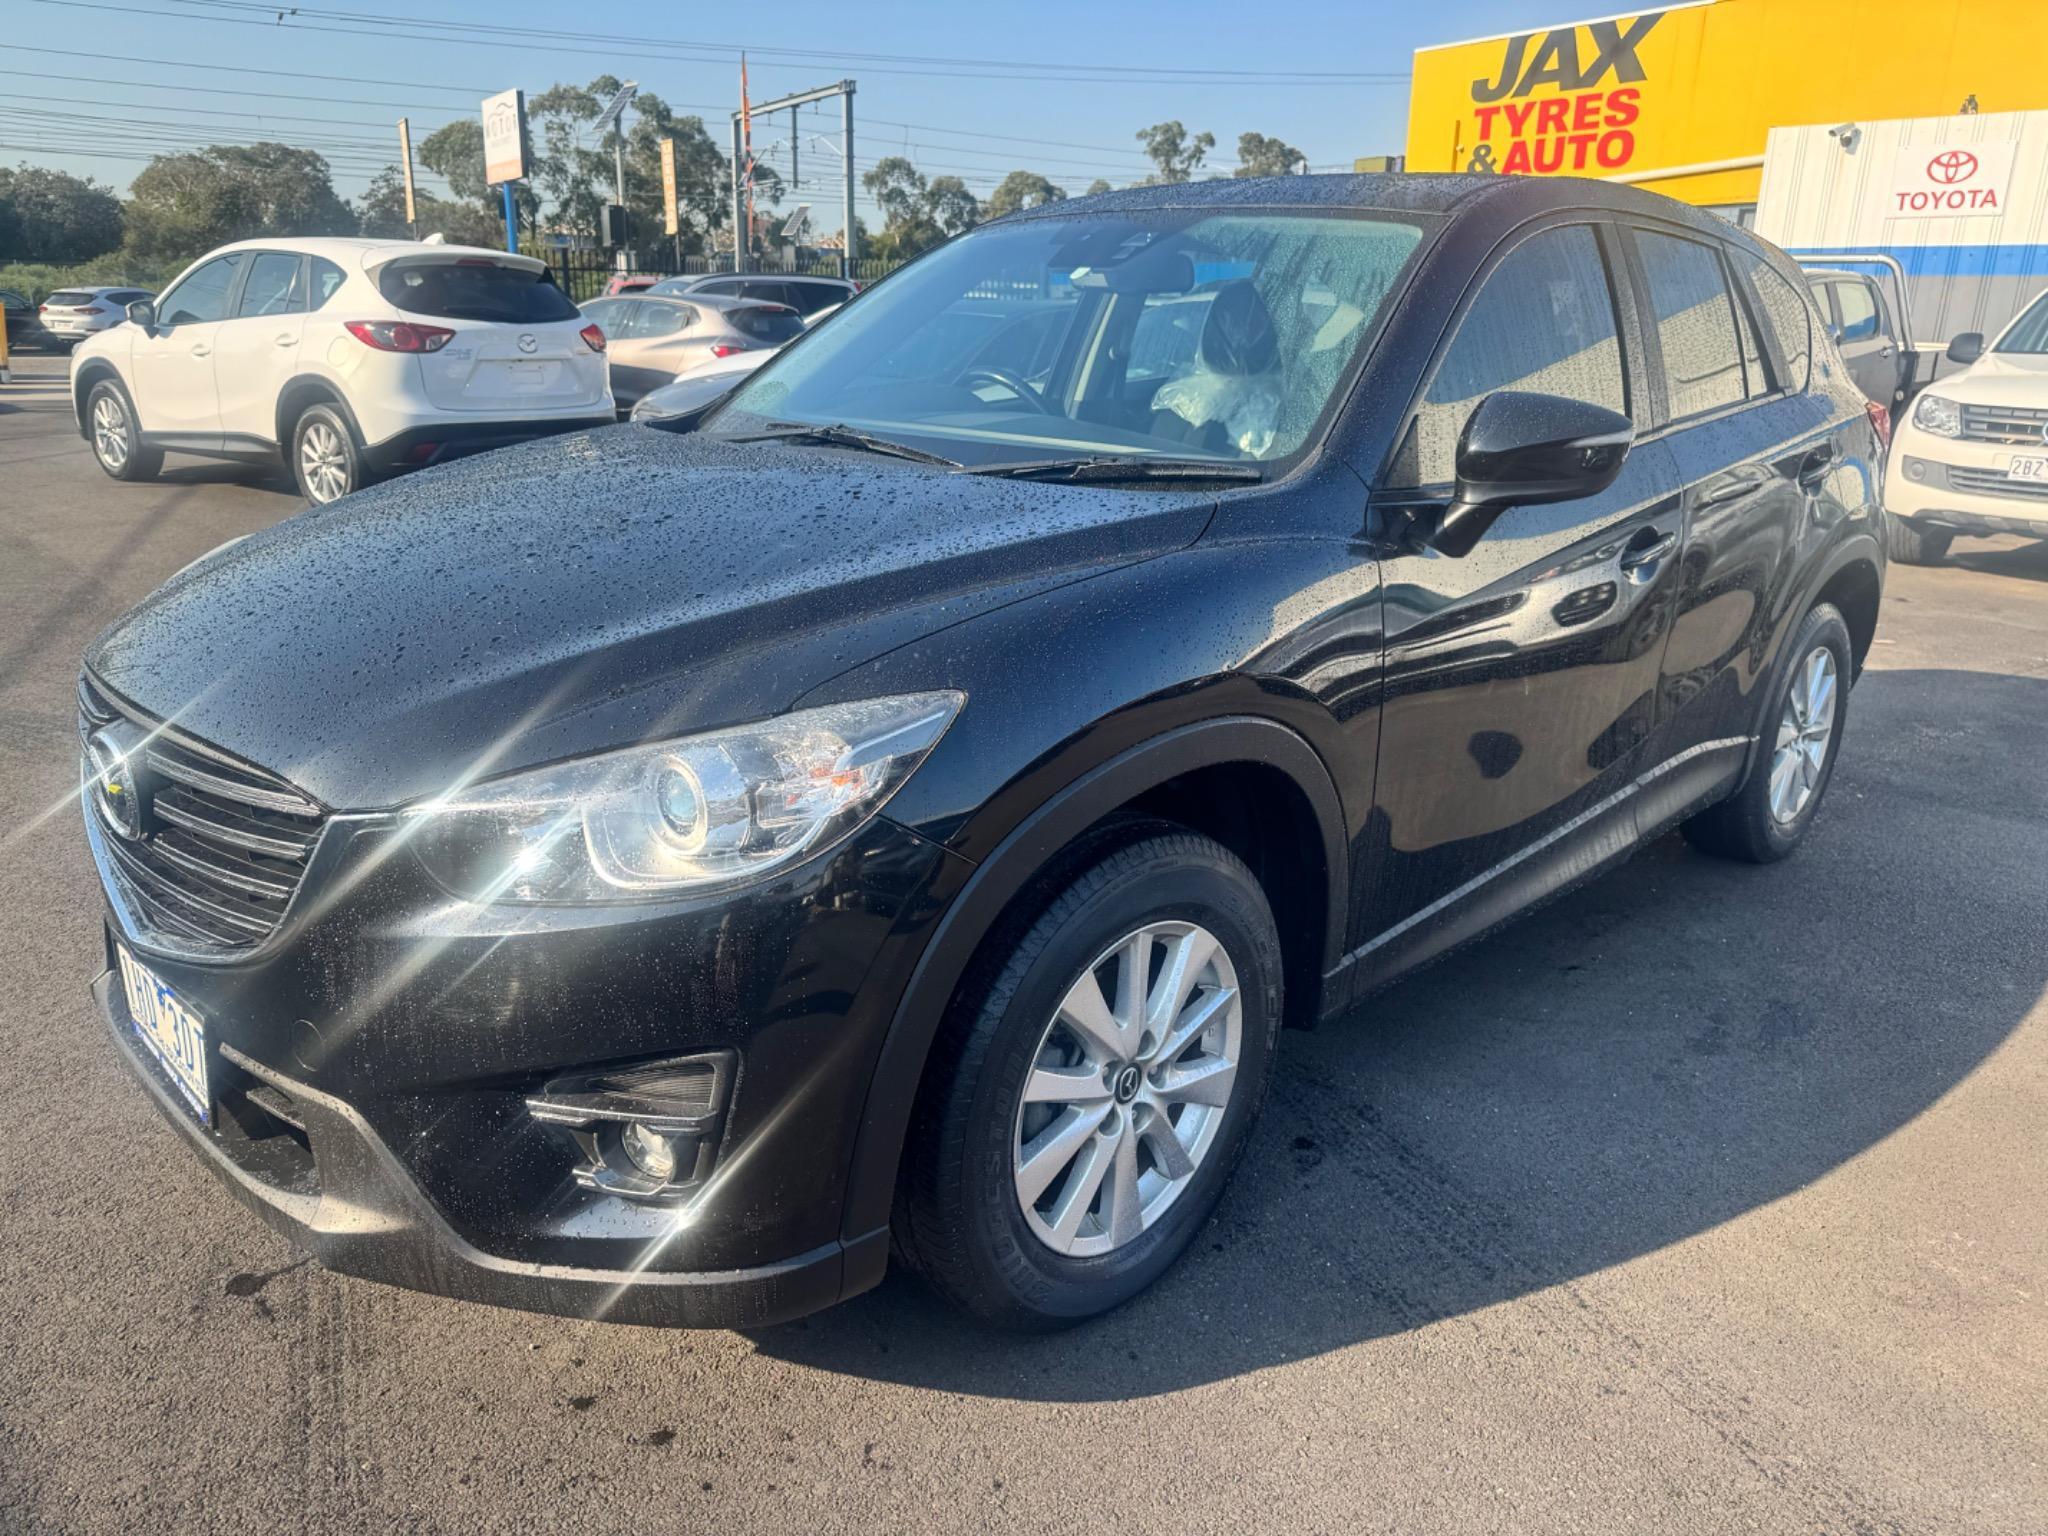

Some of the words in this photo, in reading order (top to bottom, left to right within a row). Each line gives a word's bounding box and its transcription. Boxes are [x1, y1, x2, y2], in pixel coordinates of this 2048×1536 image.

[1471, 11, 1667, 103] JAX
[1474, 88, 1641, 141] TYRES
[1467, 144, 1497, 174] &
[1501, 129, 1635, 175] AUTO
[1896, 189, 1998, 211] TOYOTA
